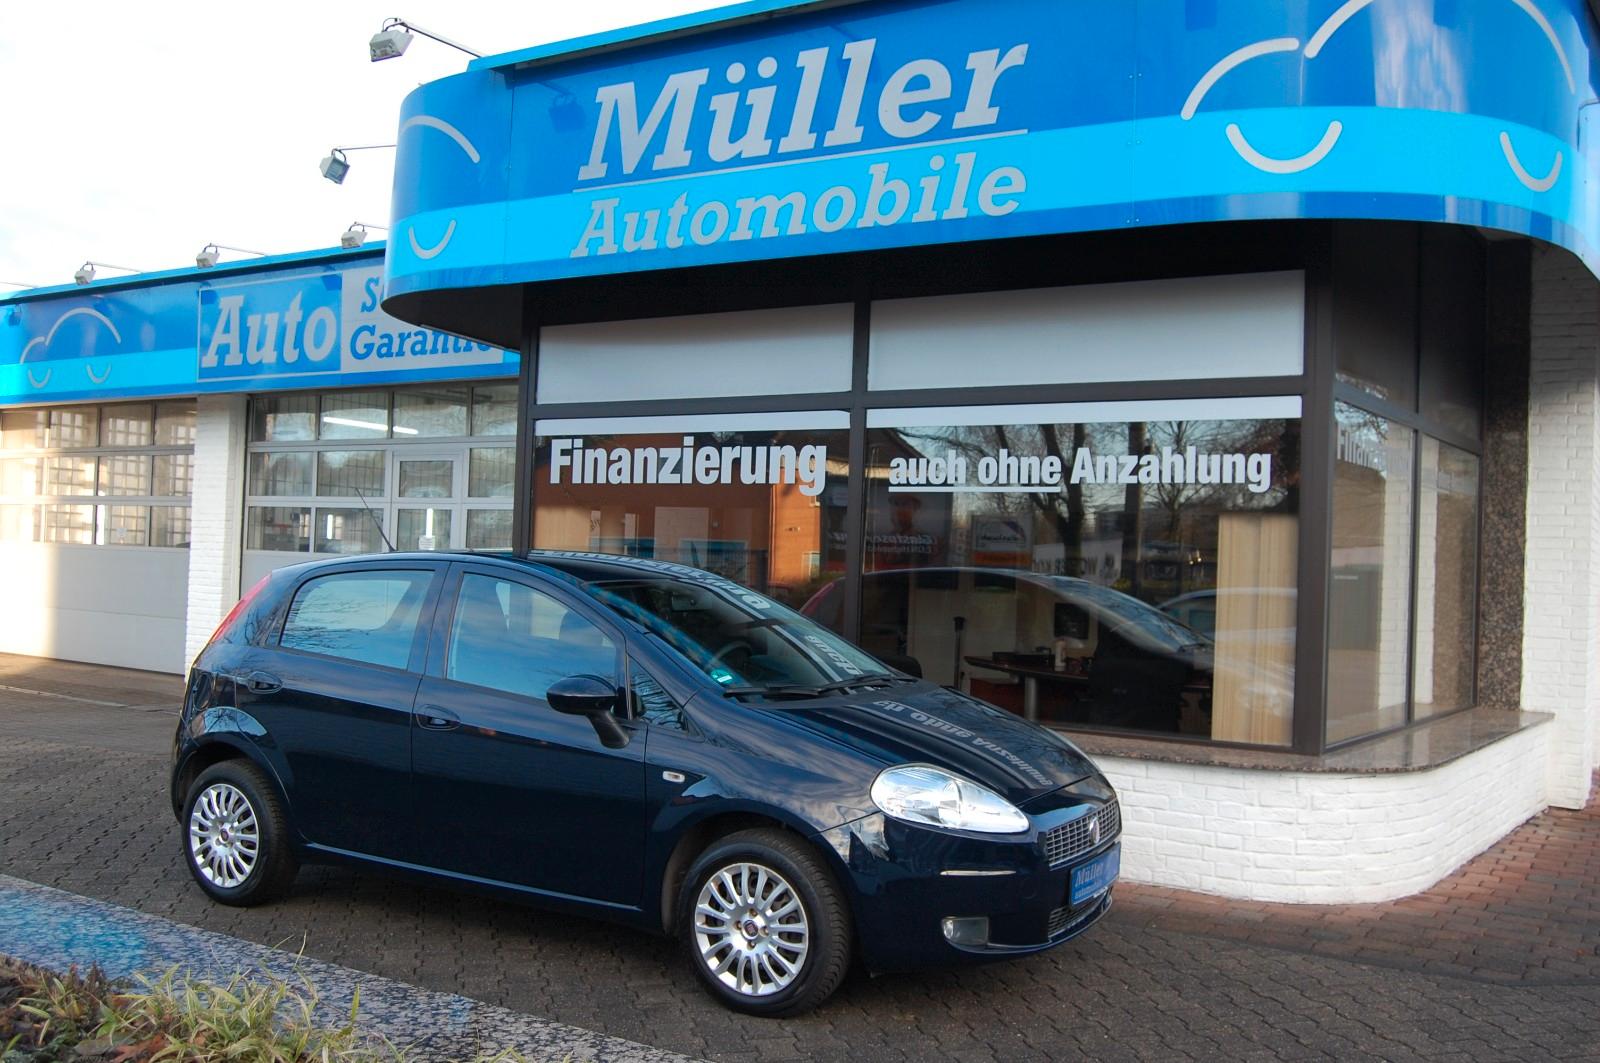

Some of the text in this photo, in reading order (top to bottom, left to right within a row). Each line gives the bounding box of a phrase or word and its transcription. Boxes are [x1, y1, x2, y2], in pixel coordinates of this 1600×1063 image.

[577, 38, 1029, 181] Müller
[569, 151, 1028, 259] Automobile
[201, 290, 337, 368] Auto
[550, 436, 827, 496] Finanzierung
[888, 445, 1272, 493] auch ohne Anzahlung
